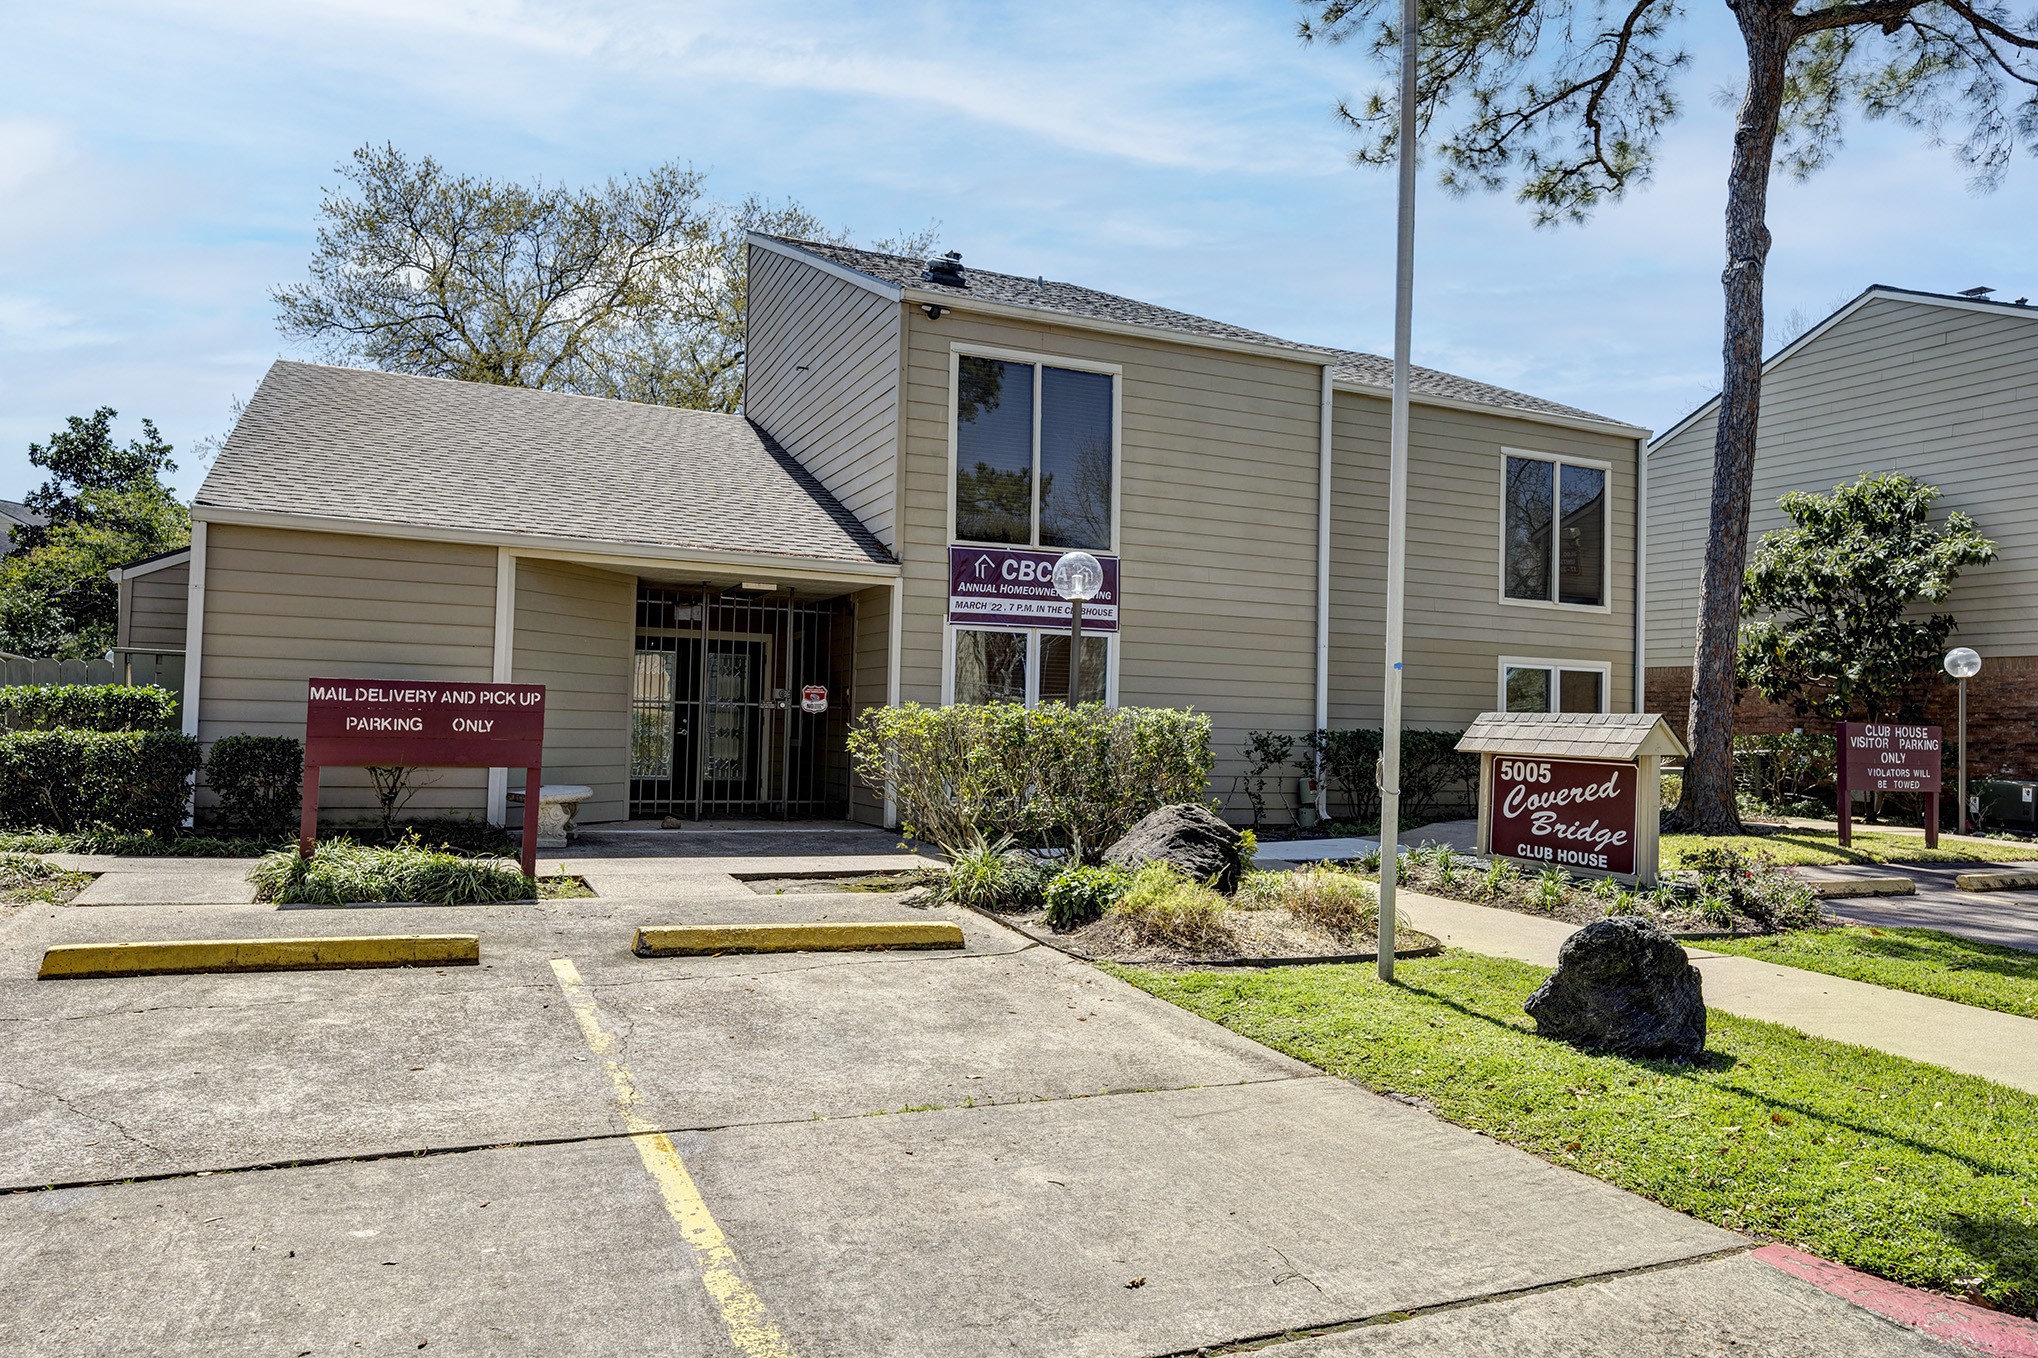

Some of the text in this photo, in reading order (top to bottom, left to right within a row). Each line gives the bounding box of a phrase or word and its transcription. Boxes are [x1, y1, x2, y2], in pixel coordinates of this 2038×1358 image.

[957, 582, 998, 594] ANNUAL
[954, 600, 988, 611] MARCH
[1009, 603, 1015, 612] 7
[1016, 604, 1035, 613] P.M.
[1036, 605, 1046, 614] IN
[1047, 606, 1063, 615] THE
[1064, 606, 1114, 617] CBHOUSE
[310, 686, 542, 706] MAIL DELIVERY AND PICK UP
[345, 716, 495, 733] PARKING ONLY
[1865, 724, 1929, 739] CLUB HOUSE
[1850, 736, 1939, 751] VISITOR PARKING
[1880, 752, 1906, 764] ONLY
[1500, 760, 1552, 784] 5005
[1867, 768, 1931, 778] VIOLATORS WILL
[1877, 780, 1921, 789] BE TOWED
[1502, 770, 1621, 819] Covered
[1530, 810, 1628, 852] Bridge
[1517, 843, 1608, 869] CLUB HOUSE
